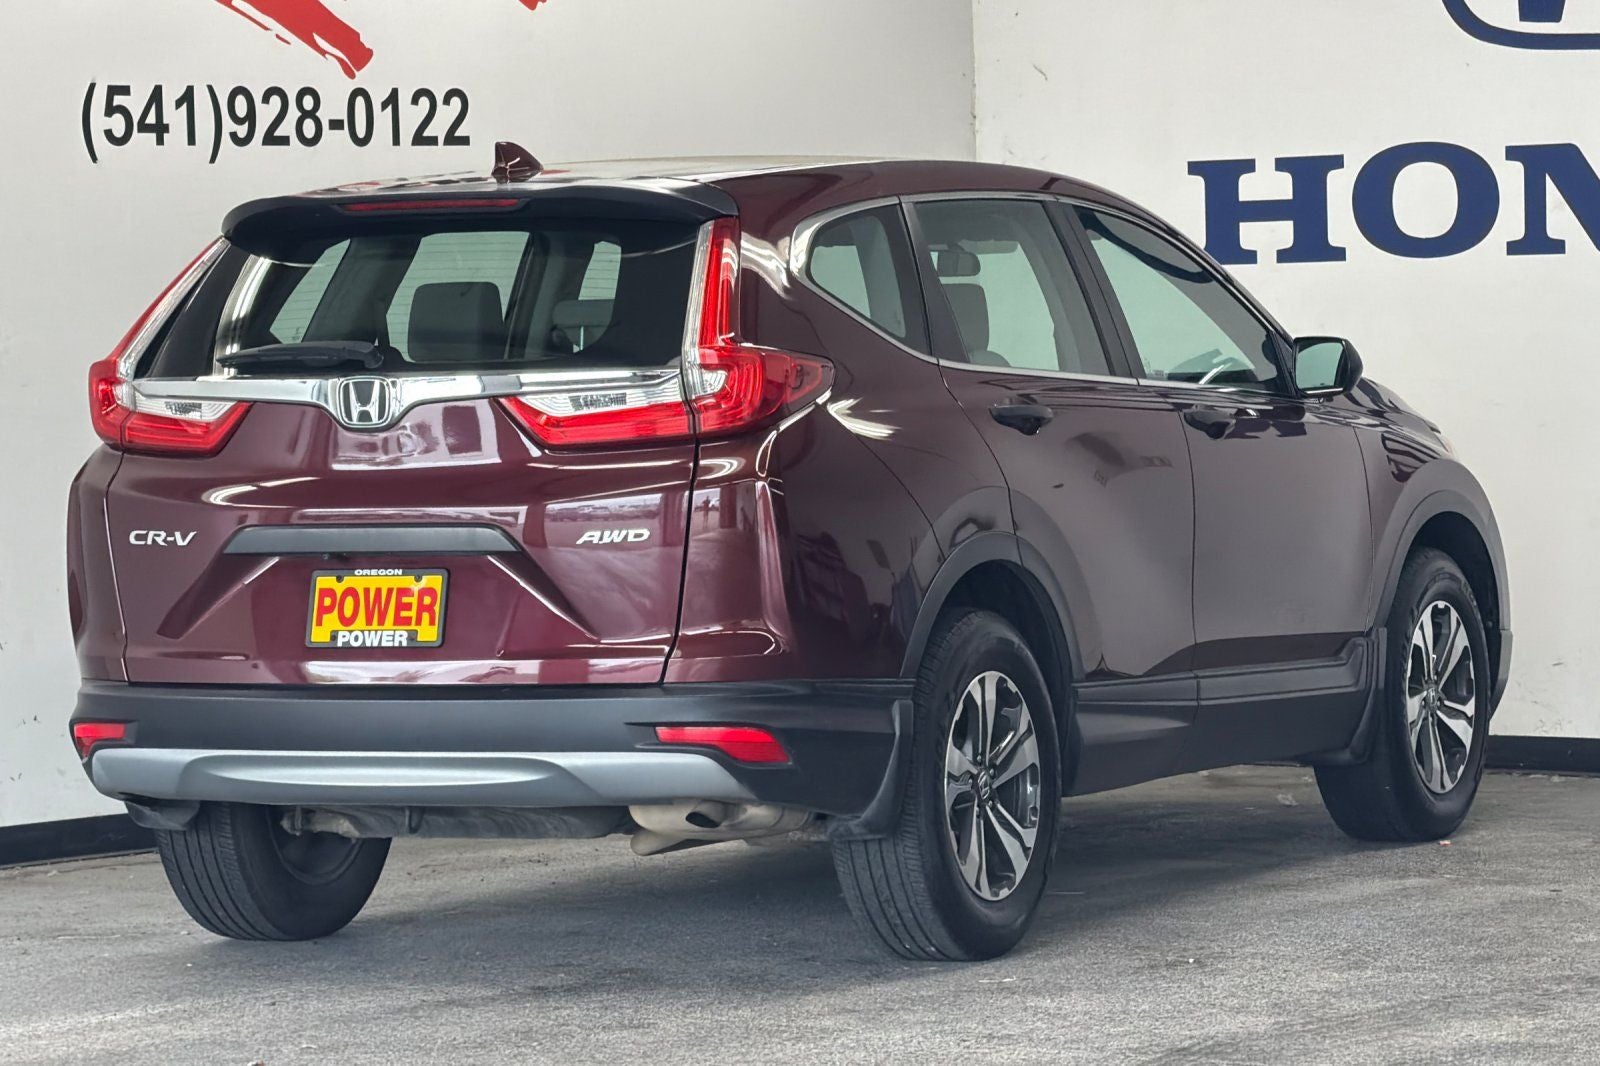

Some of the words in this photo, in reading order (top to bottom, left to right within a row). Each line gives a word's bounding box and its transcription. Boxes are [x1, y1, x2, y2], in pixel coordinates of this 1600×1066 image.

[81, 82, 471, 164] (541)928-0122
[128, 530, 197, 546] CR-V
[575, 528, 651, 545] AWD
[354, 568, 403, 576] OREGON
[315, 586, 438, 628] POWER
[336, 630, 409, 647] POWER
